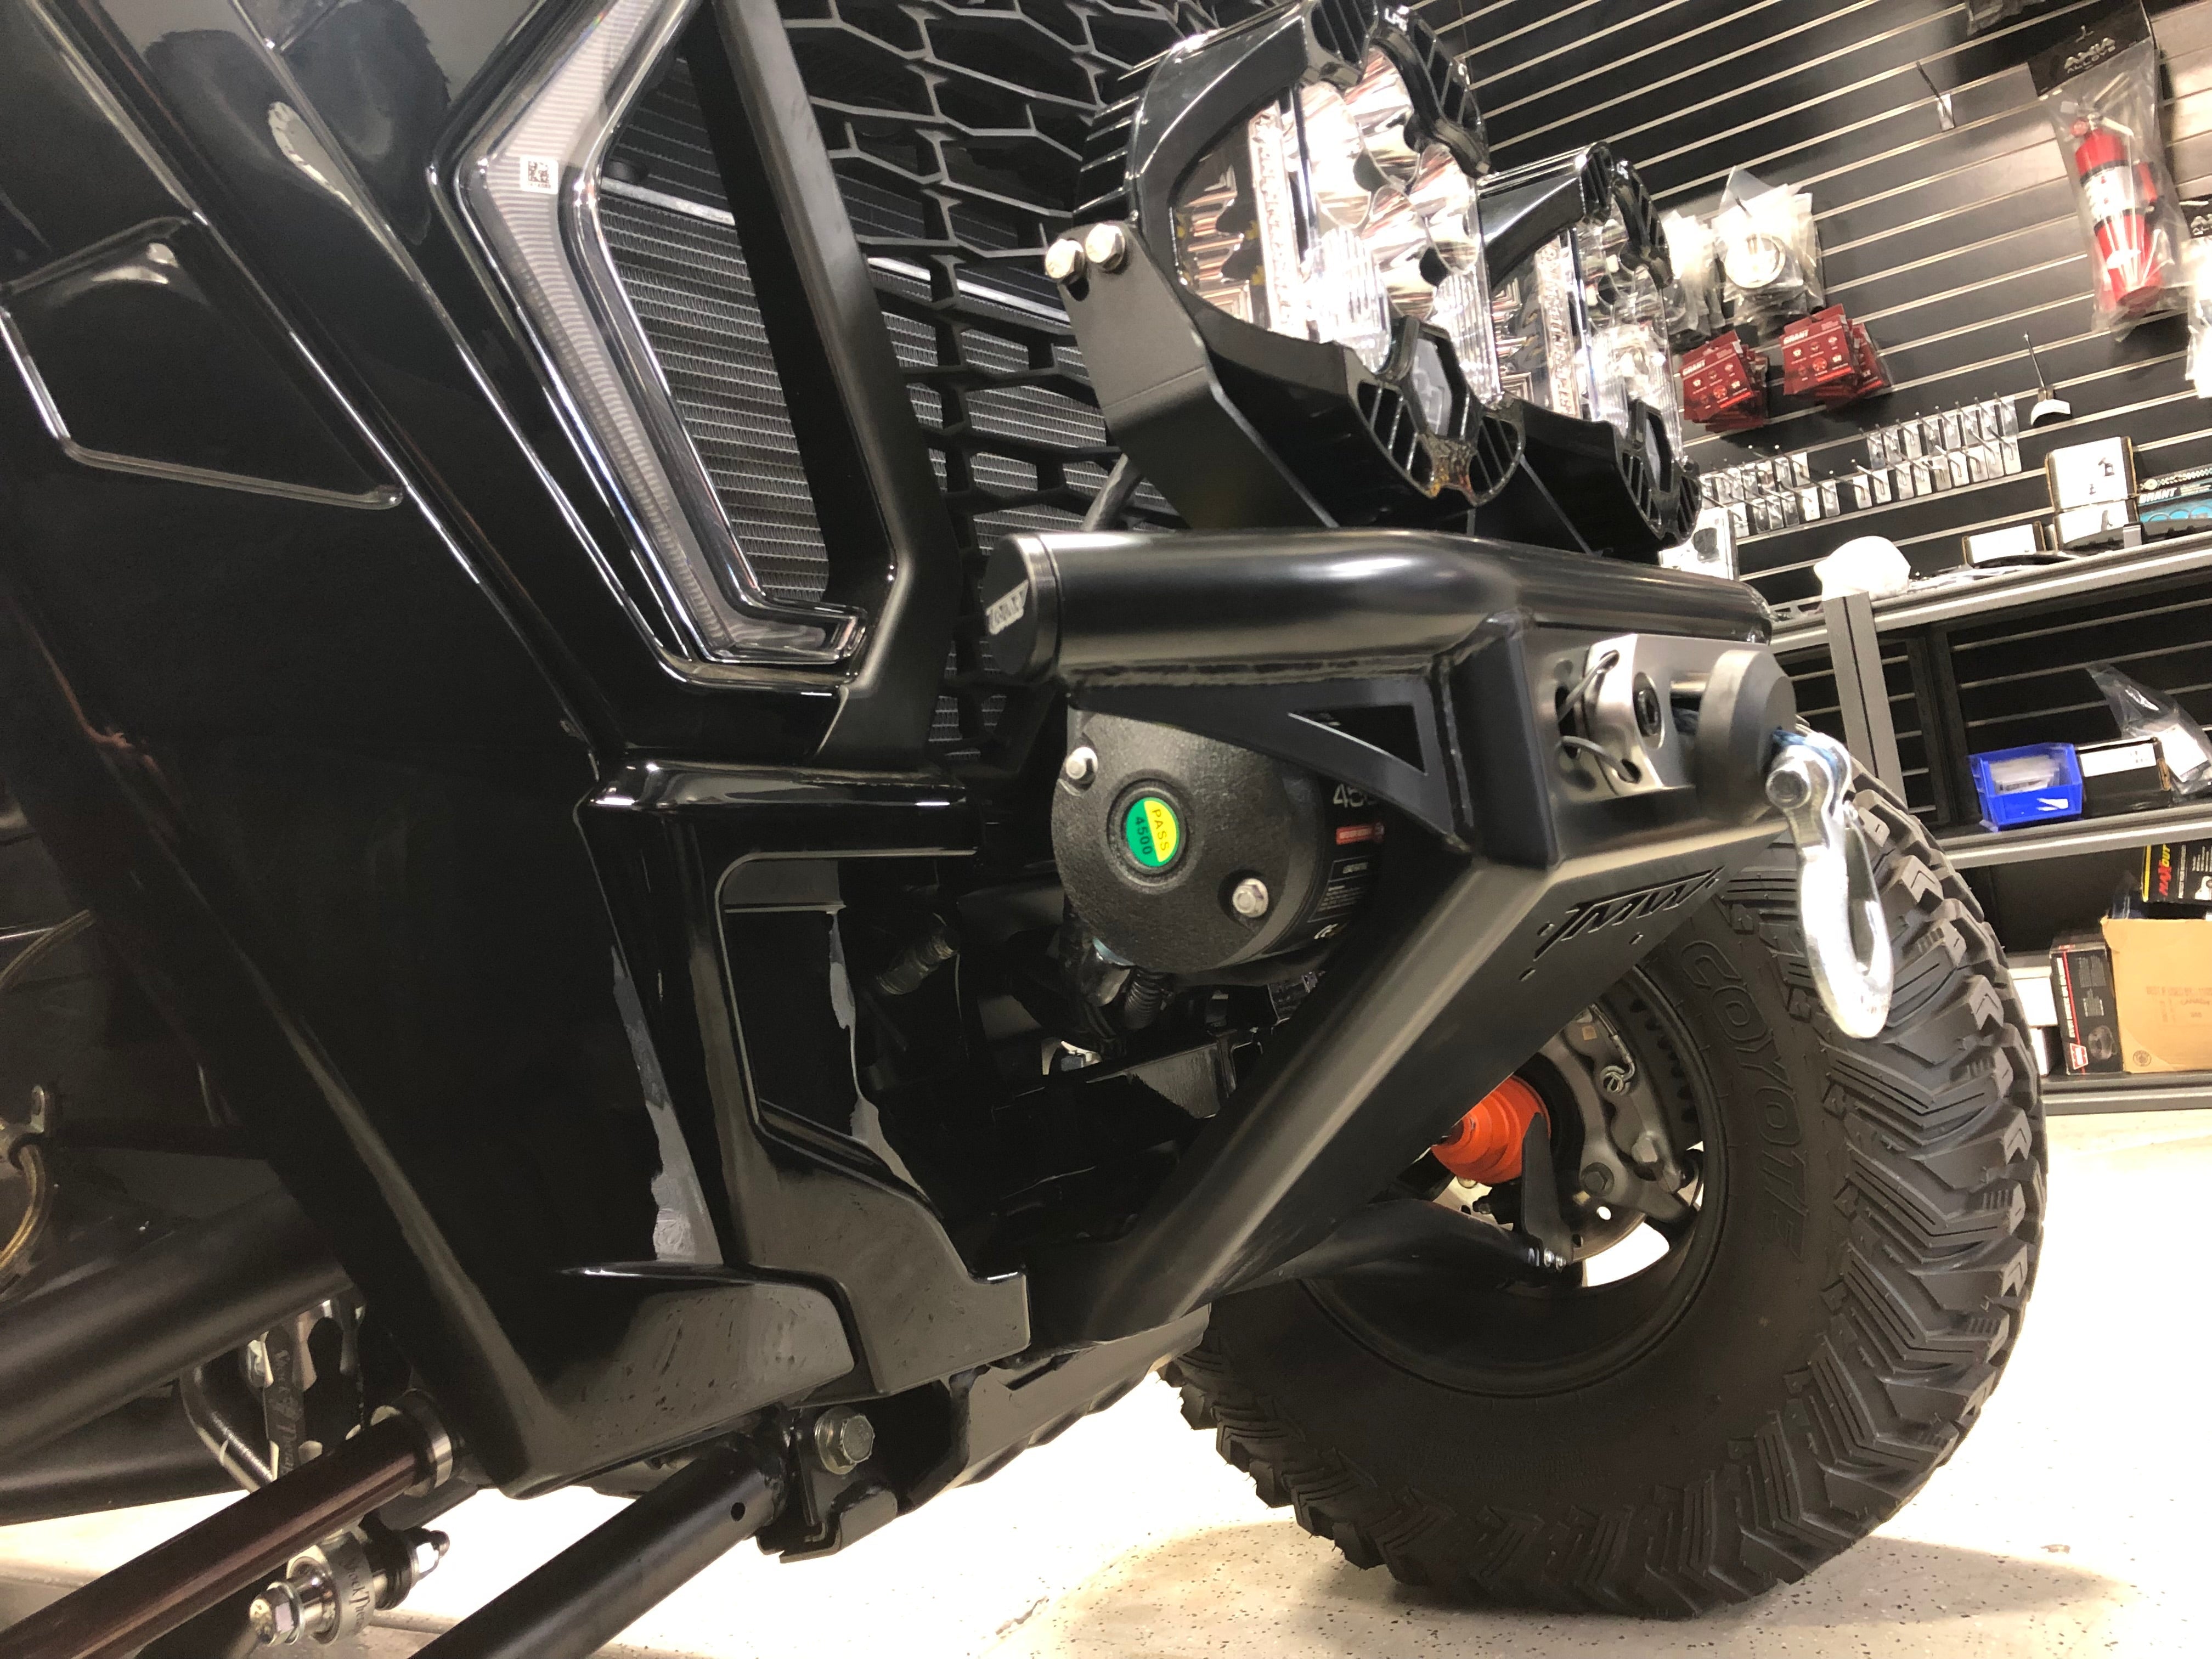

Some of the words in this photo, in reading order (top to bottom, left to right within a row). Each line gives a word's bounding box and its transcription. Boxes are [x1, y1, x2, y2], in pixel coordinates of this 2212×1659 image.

[1136, 816, 1153, 855] 4500
[1152, 809, 1169, 851] PASS
[1681, 940, 1809, 1261] COYOTE
